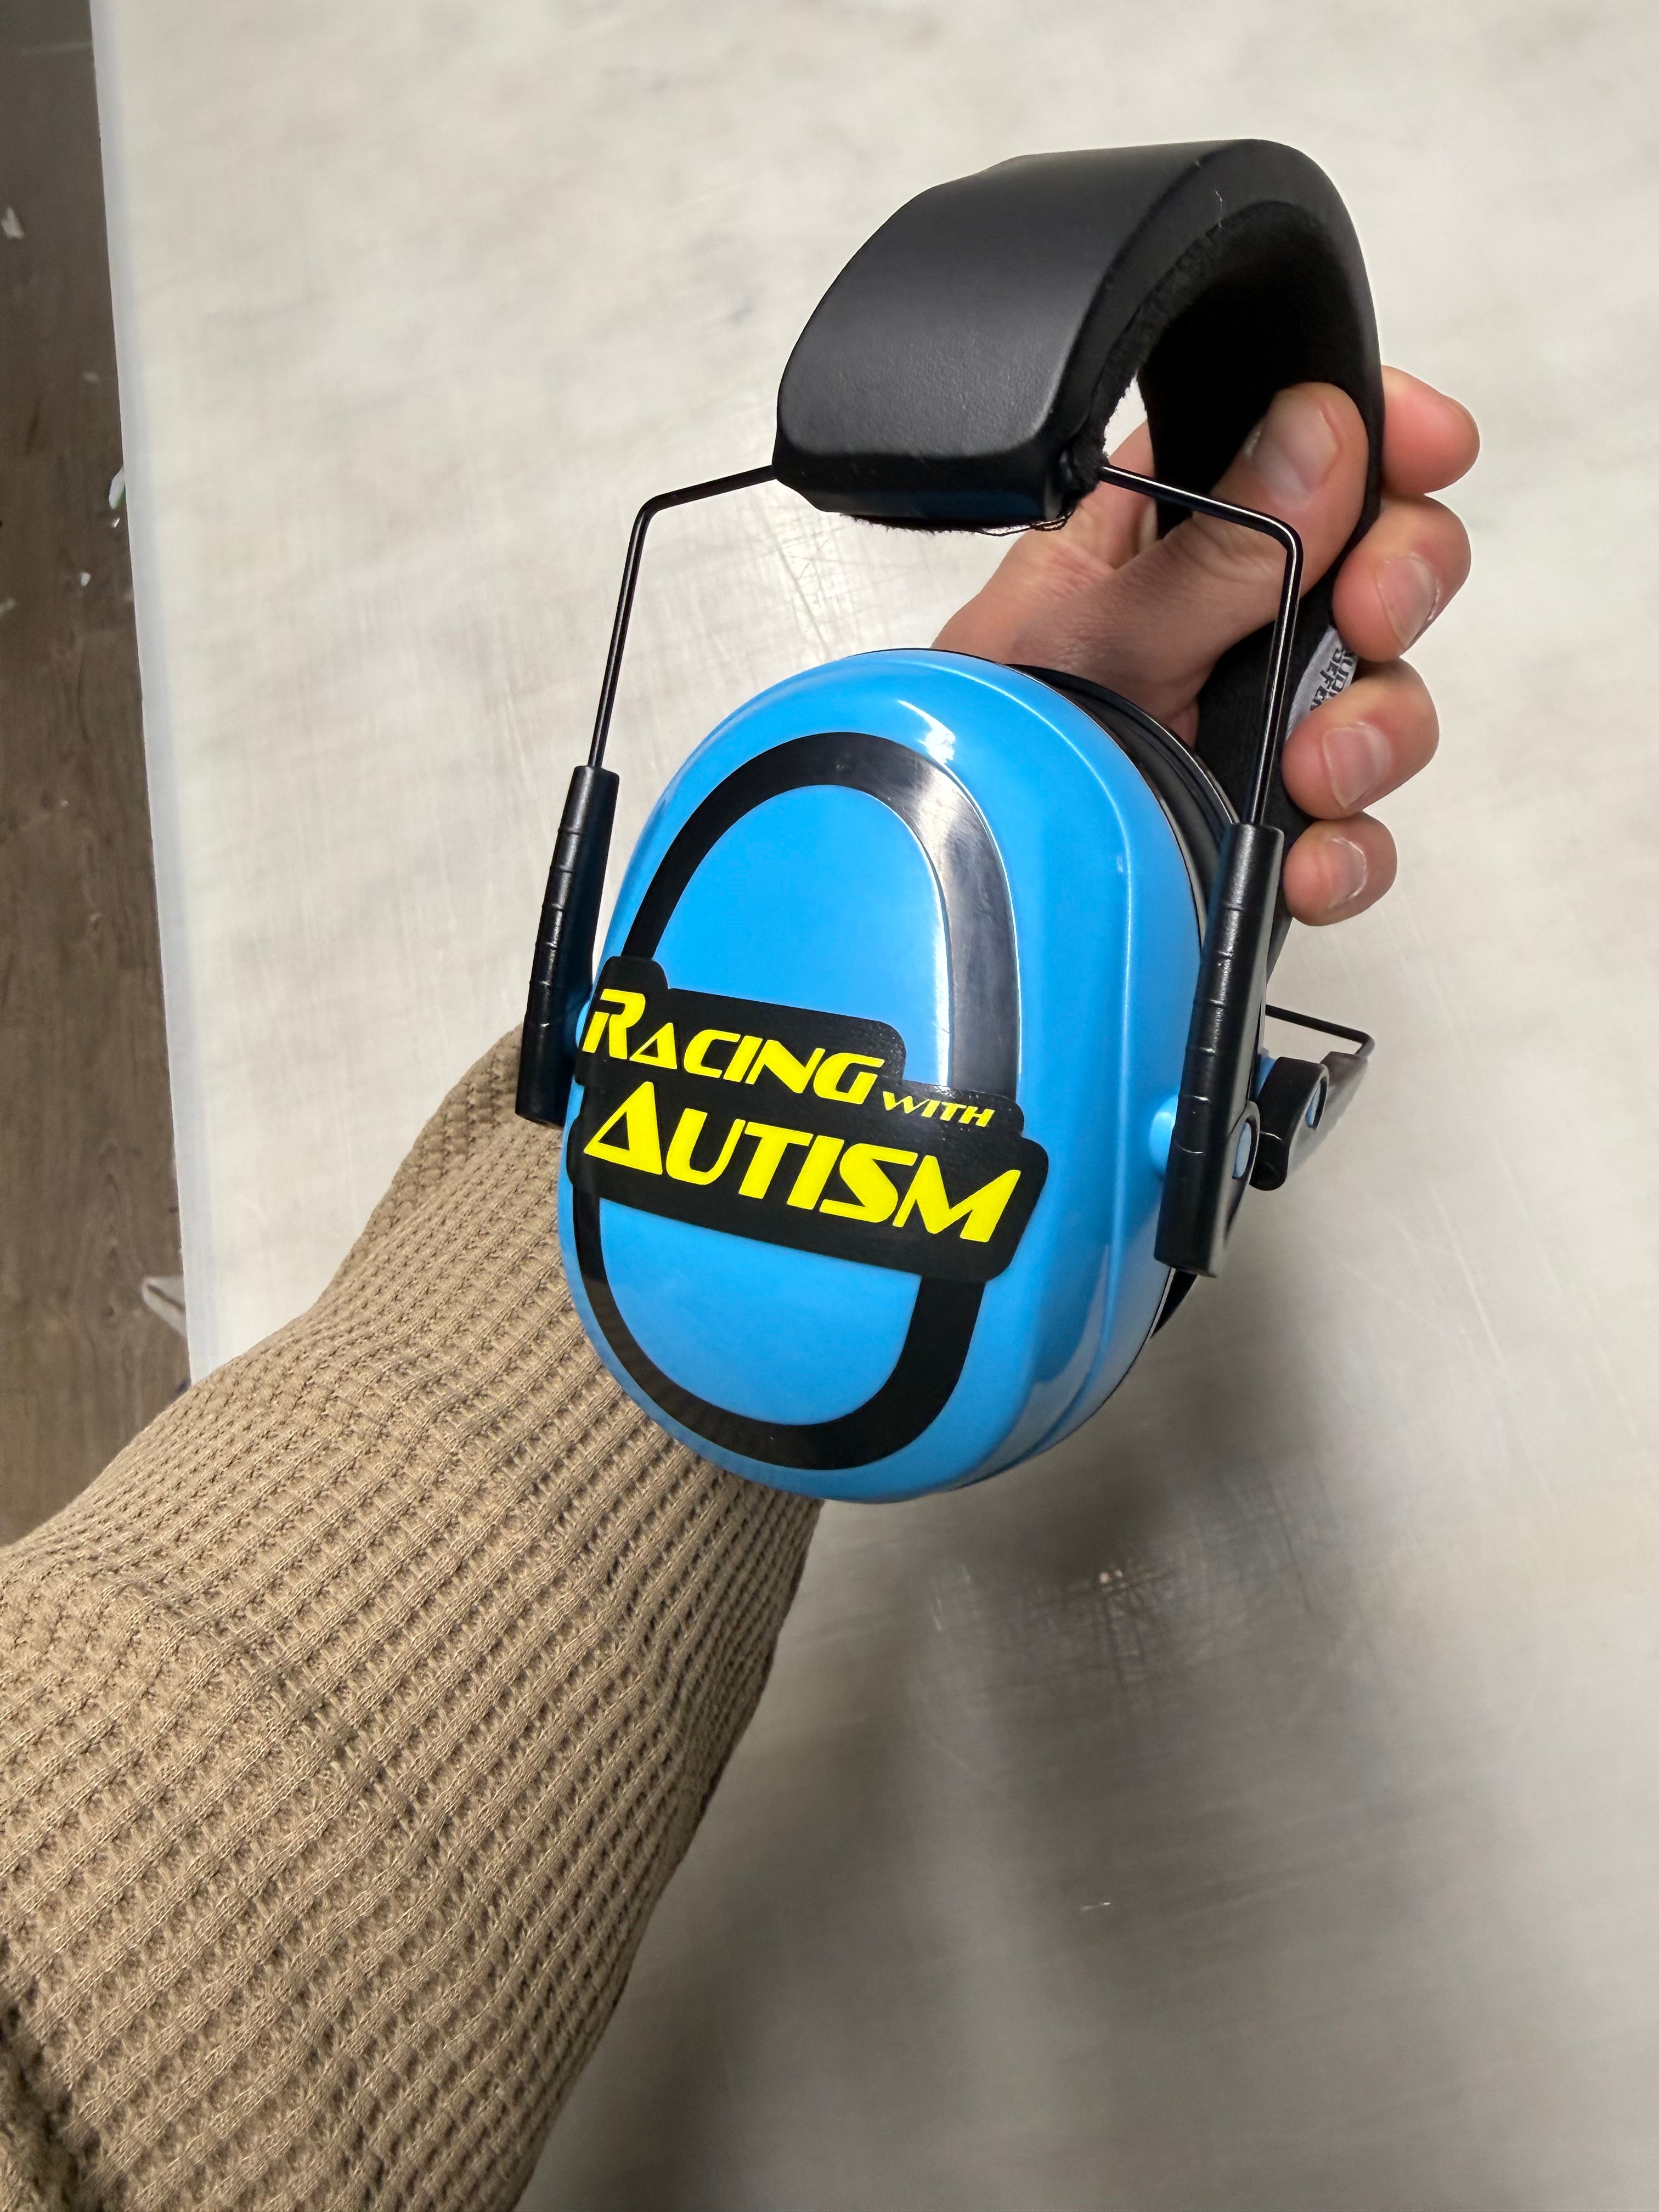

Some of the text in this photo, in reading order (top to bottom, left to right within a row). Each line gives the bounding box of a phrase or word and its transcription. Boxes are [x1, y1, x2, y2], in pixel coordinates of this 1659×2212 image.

[582, 988, 994, 1127] RACING WITH
[584, 1081, 1022, 1243] AUTISM
